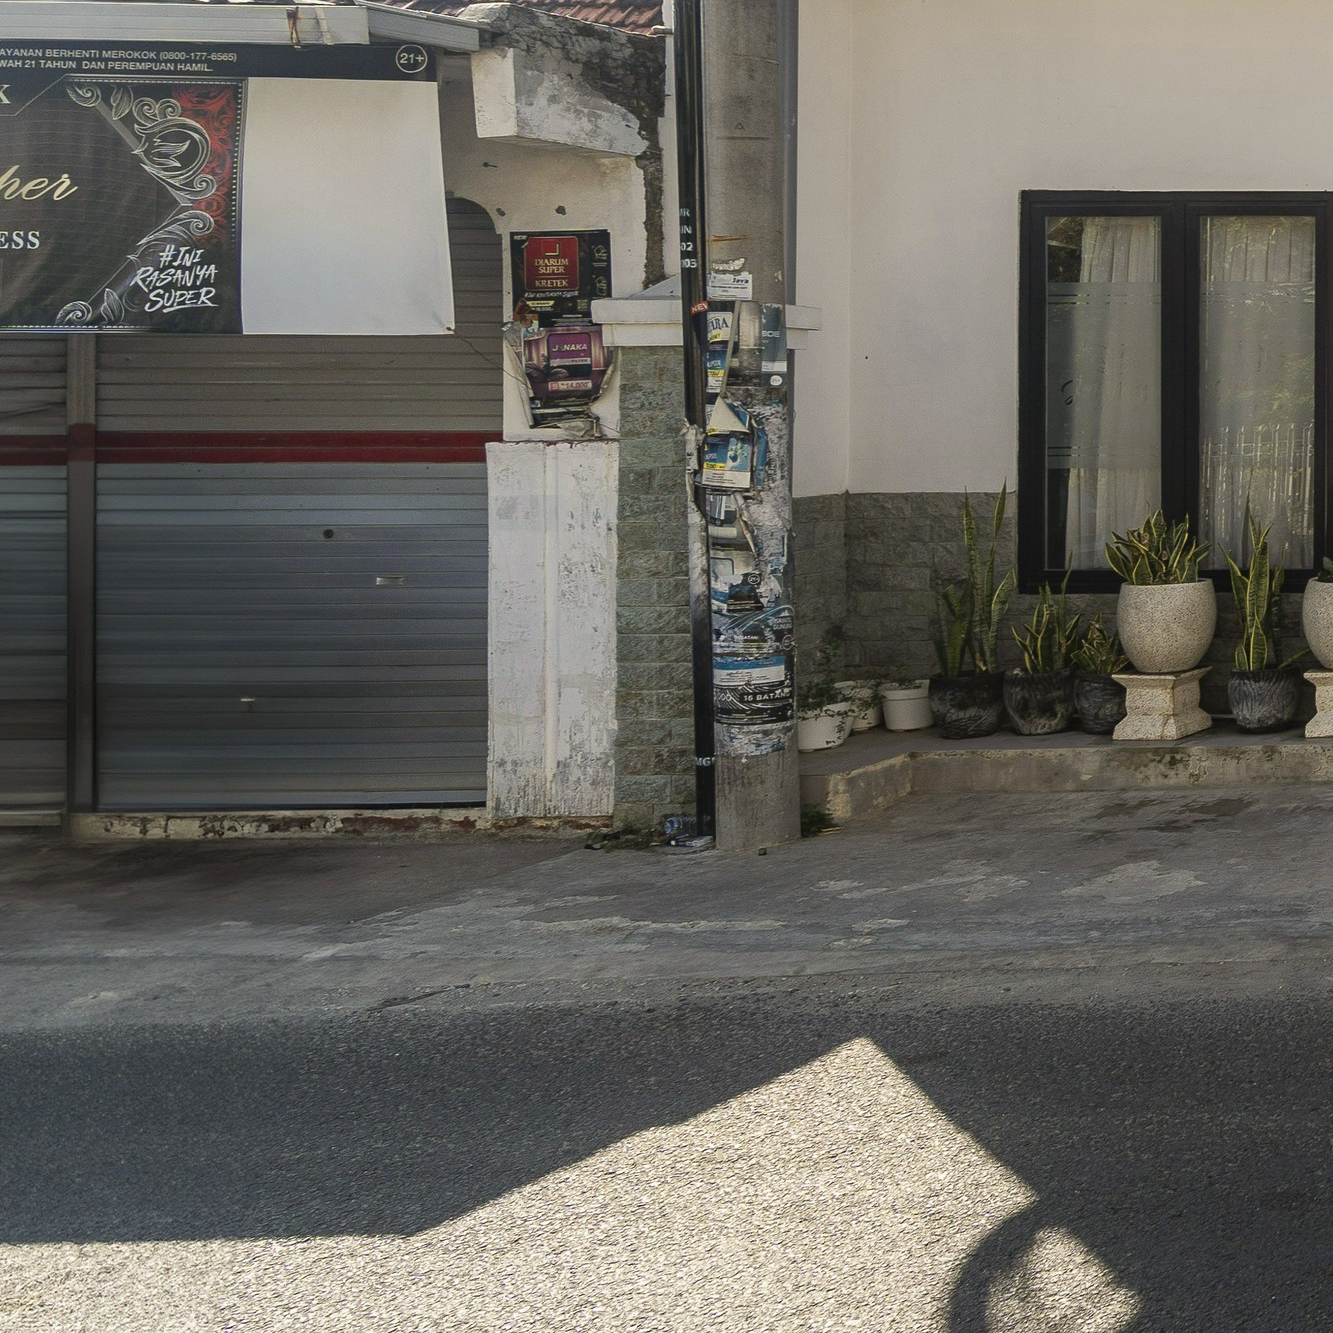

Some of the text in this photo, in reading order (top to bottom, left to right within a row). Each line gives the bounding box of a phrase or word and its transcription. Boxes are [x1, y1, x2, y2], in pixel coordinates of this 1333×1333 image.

[45, 49, 99, 58] BERHENTI
[102, 50, 157, 60] MEROKOK
[160, 51, 237, 62] (0800-177-6565)
[400, 53, 424, 63] 21+
[24, 60, 35, 68] 21
[39, 60, 77, 69] TAHUN
[82, 61, 105, 70] DAN
[108, 61, 174, 71] PEREMPUAN
[177, 63, 213, 71] HAMIL.
[159, 244, 204, 268] #INI
[130, 265, 218, 292] RASANYA
[535, 279, 568, 287] KRETEK
[144, 287, 218, 313] SUPER
